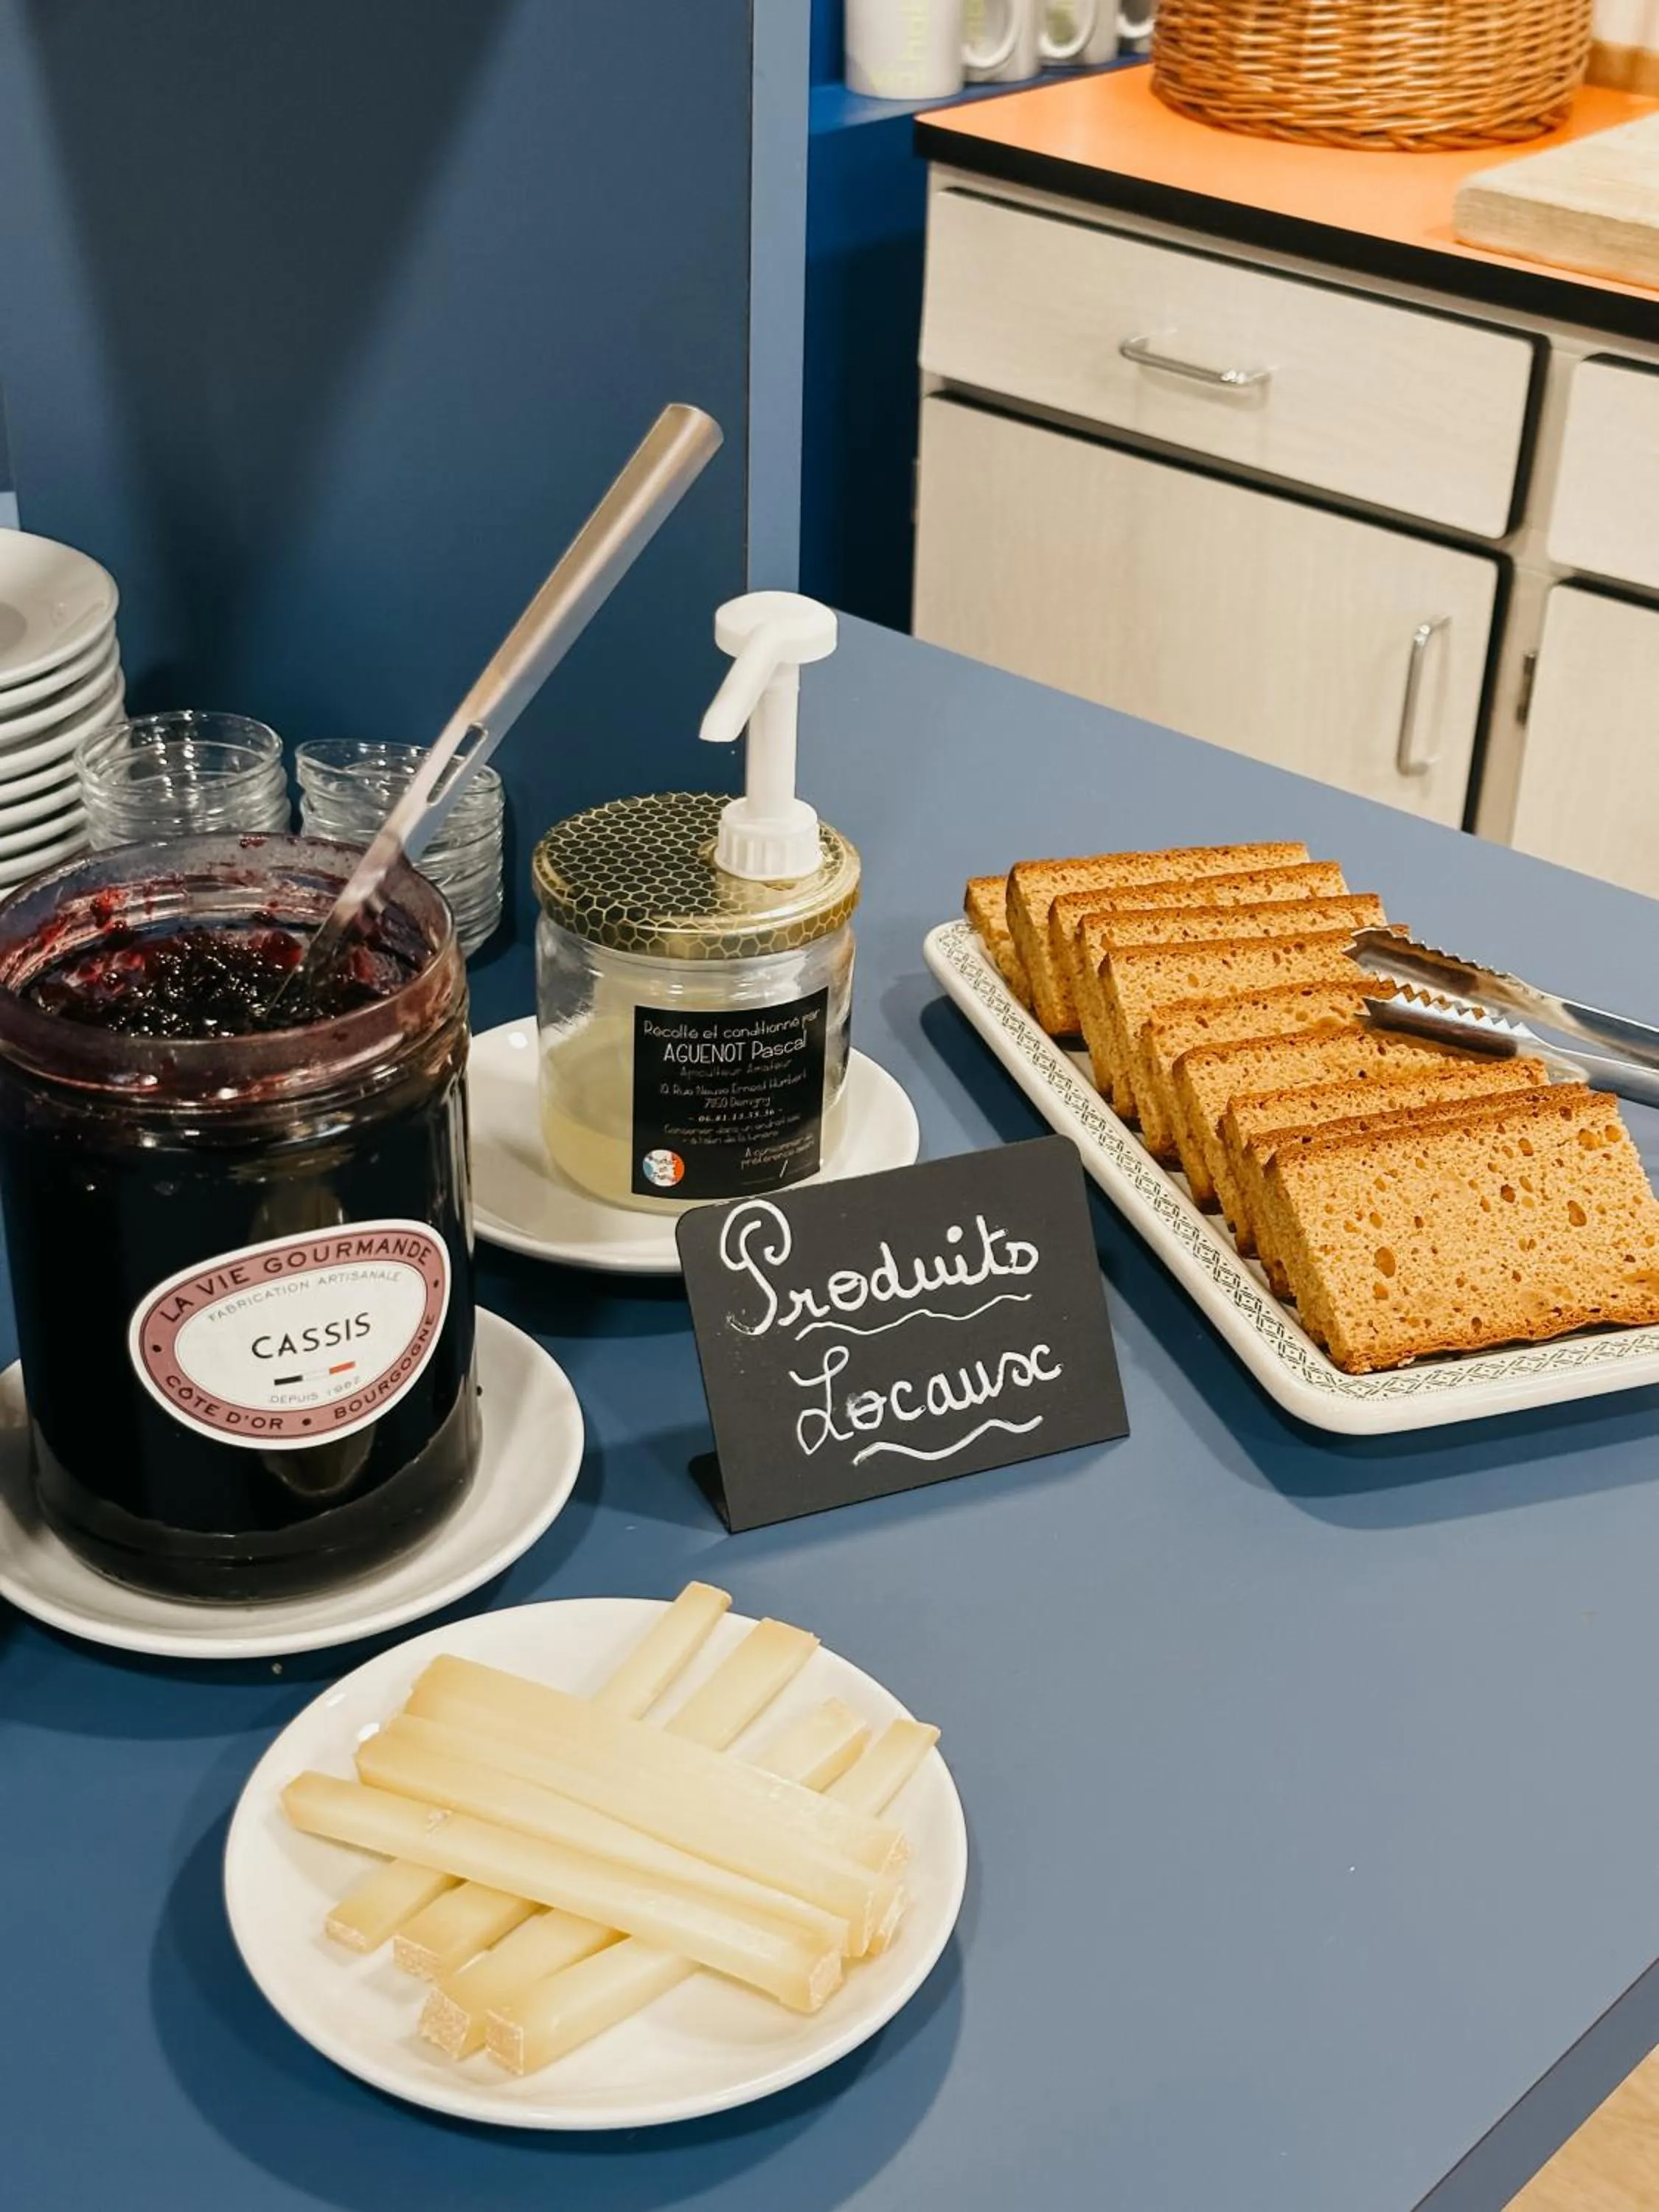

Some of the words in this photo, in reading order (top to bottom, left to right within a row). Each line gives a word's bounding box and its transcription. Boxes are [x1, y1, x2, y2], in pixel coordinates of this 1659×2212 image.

[664, 1043, 745, 1063] AGUENOT
[751, 1029, 807, 1060] Pascal
[703, 1024, 717, 1040] et
[160, 1295, 193, 1322] LA
[196, 1266, 251, 1297] VIE
[265, 1237, 432, 1273] GOURMANDE
[720, 1200, 1039, 1335] Produits
[208, 1281, 310, 1321] FABRICATION
[318, 1270, 401, 1287] ARTISANALE
[251, 1312, 370, 1359] CASSIS
[165, 1374, 217, 1416] CÔTE
[226, 1413, 283, 1430] D'OR
[333, 1315, 434, 1420] BOURGOGNE
[270, 1391, 319, 1405] DEPUIS
[789, 1345, 1062, 1455] Locaux
